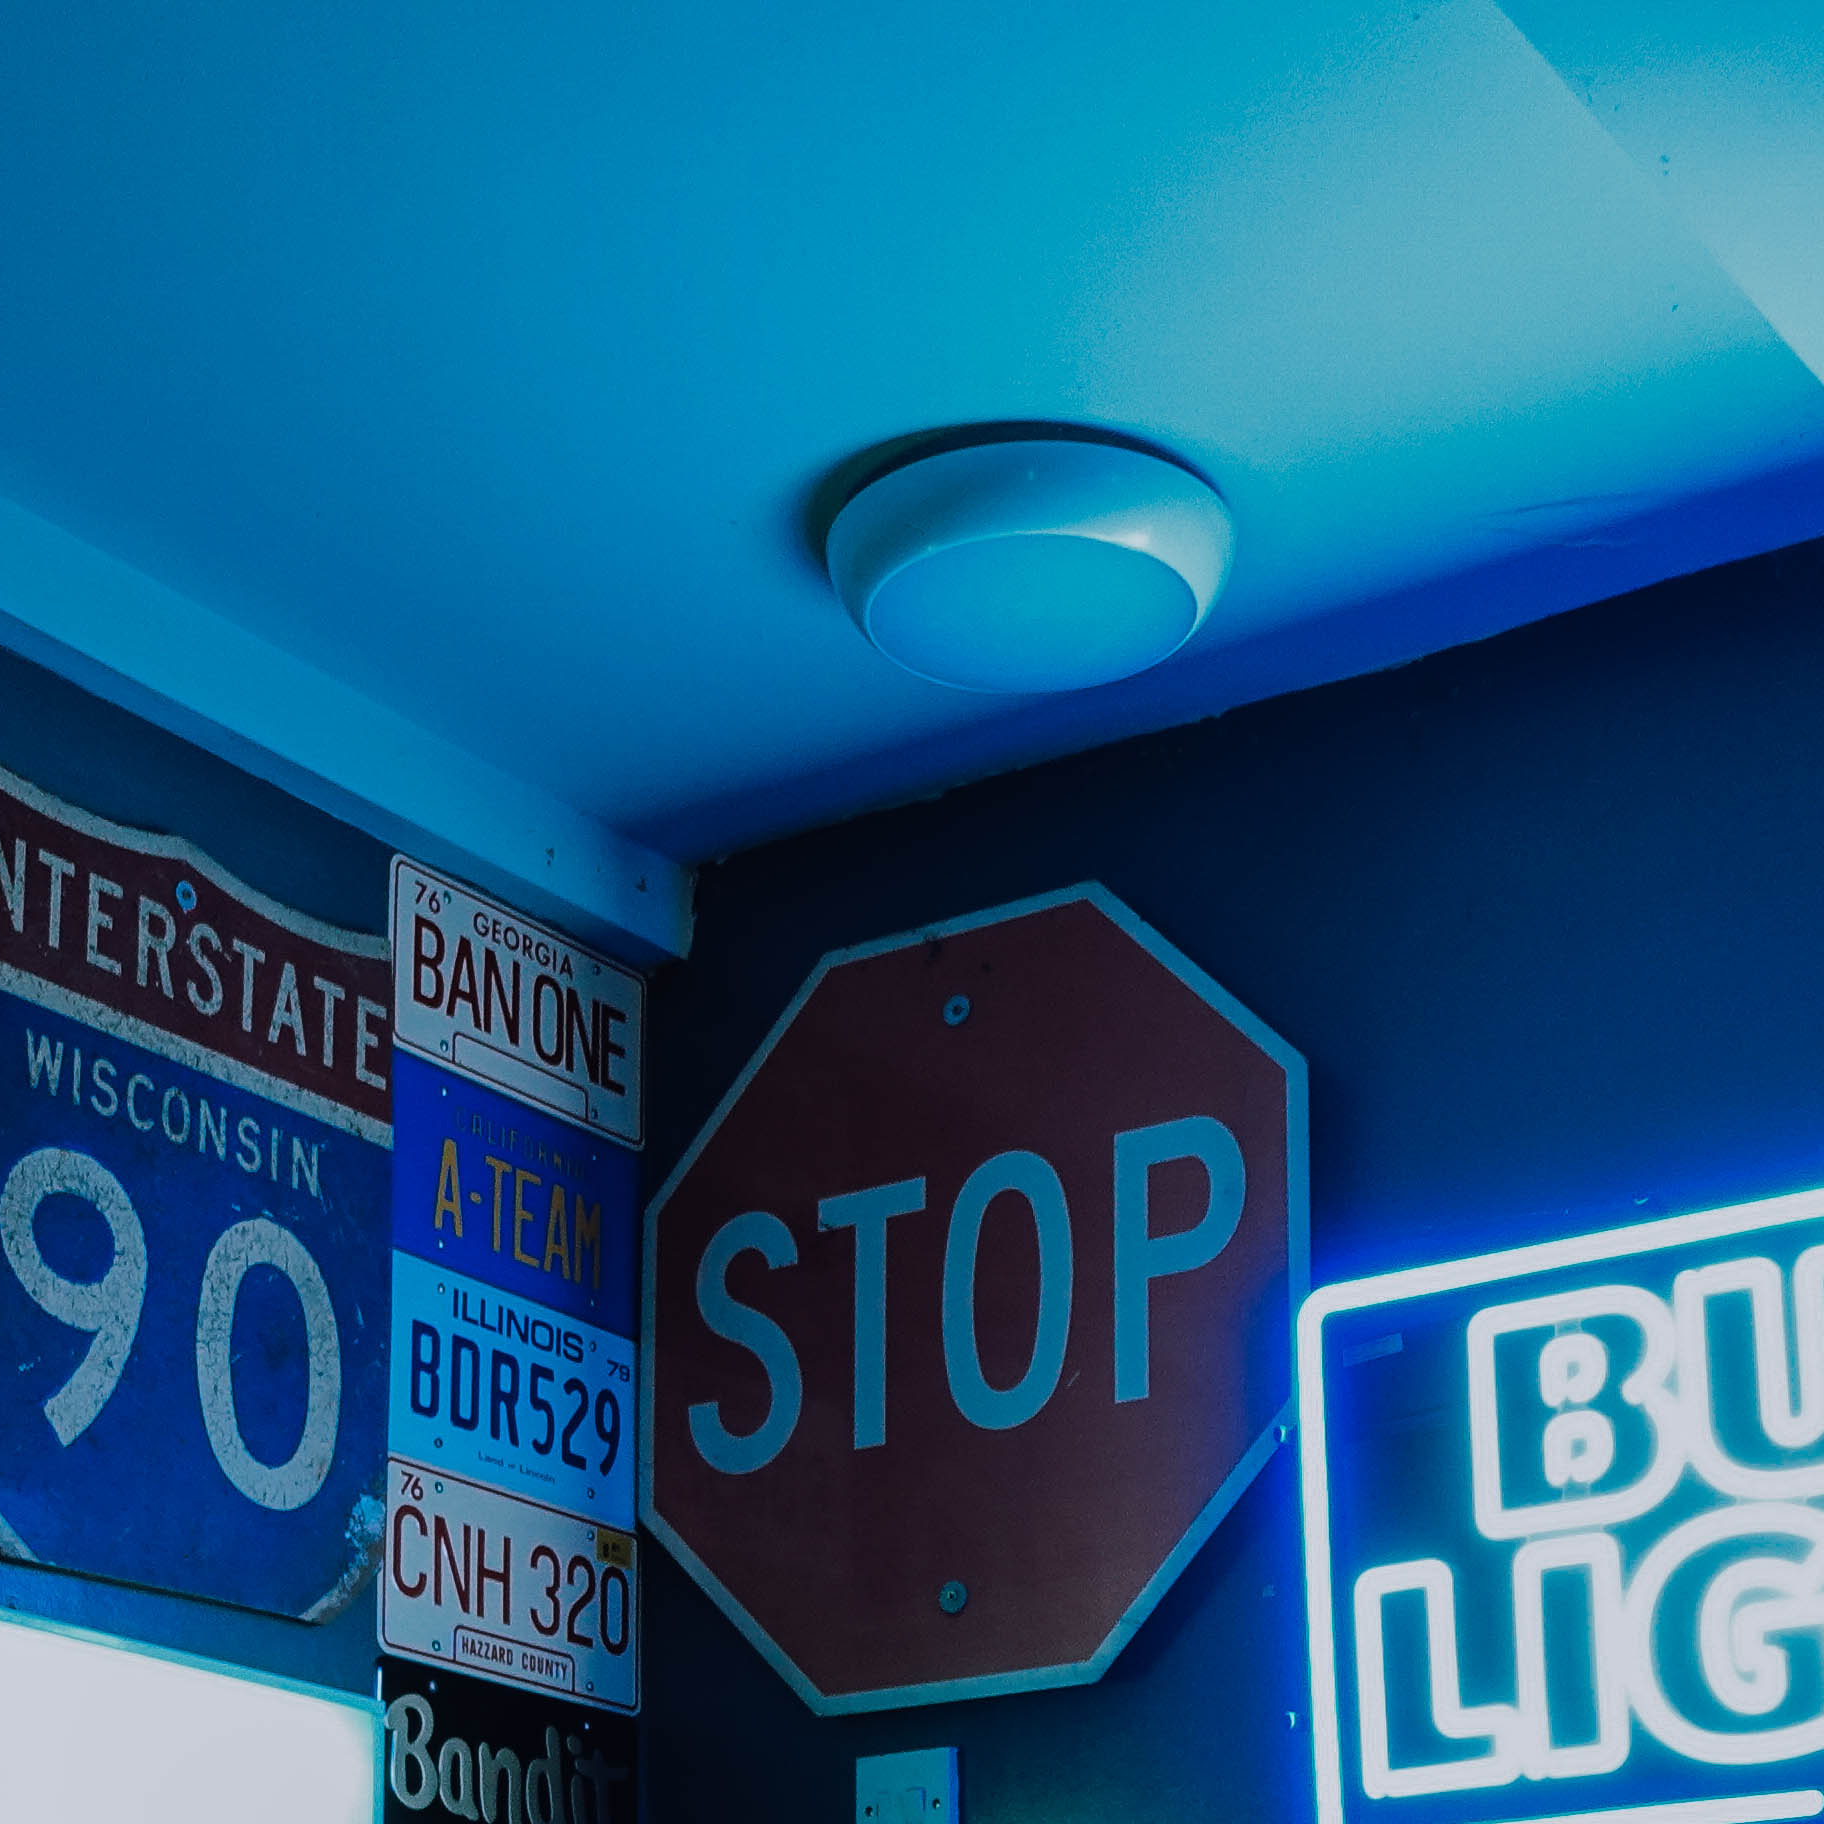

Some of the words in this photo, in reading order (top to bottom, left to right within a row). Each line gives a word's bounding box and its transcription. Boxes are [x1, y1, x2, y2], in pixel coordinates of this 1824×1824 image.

[414, 880, 441, 914] 76
[473, 911, 573, 980] GEORGIA
[412, 913, 521, 1047] BAN
[532, 974, 626, 1095] ONE
[25, 1027, 321, 1198] WISCONSIN
[456, 1105, 585, 1182] CALIFORNIA
[0, 1146, 342, 1511] 90
[452, 1287, 584, 1364] ILLINOIS
[688, 1115, 1245, 1476] STOP
[410, 1319, 621, 1476] BDR529
[399, 1471, 424, 1501] 76
[392, 1504, 512, 1626] CNH
[530, 1545, 629, 1657] 320
[461, 1637, 514, 1667] HAZZARD
[521, 1652, 569, 1682] COUNTY
